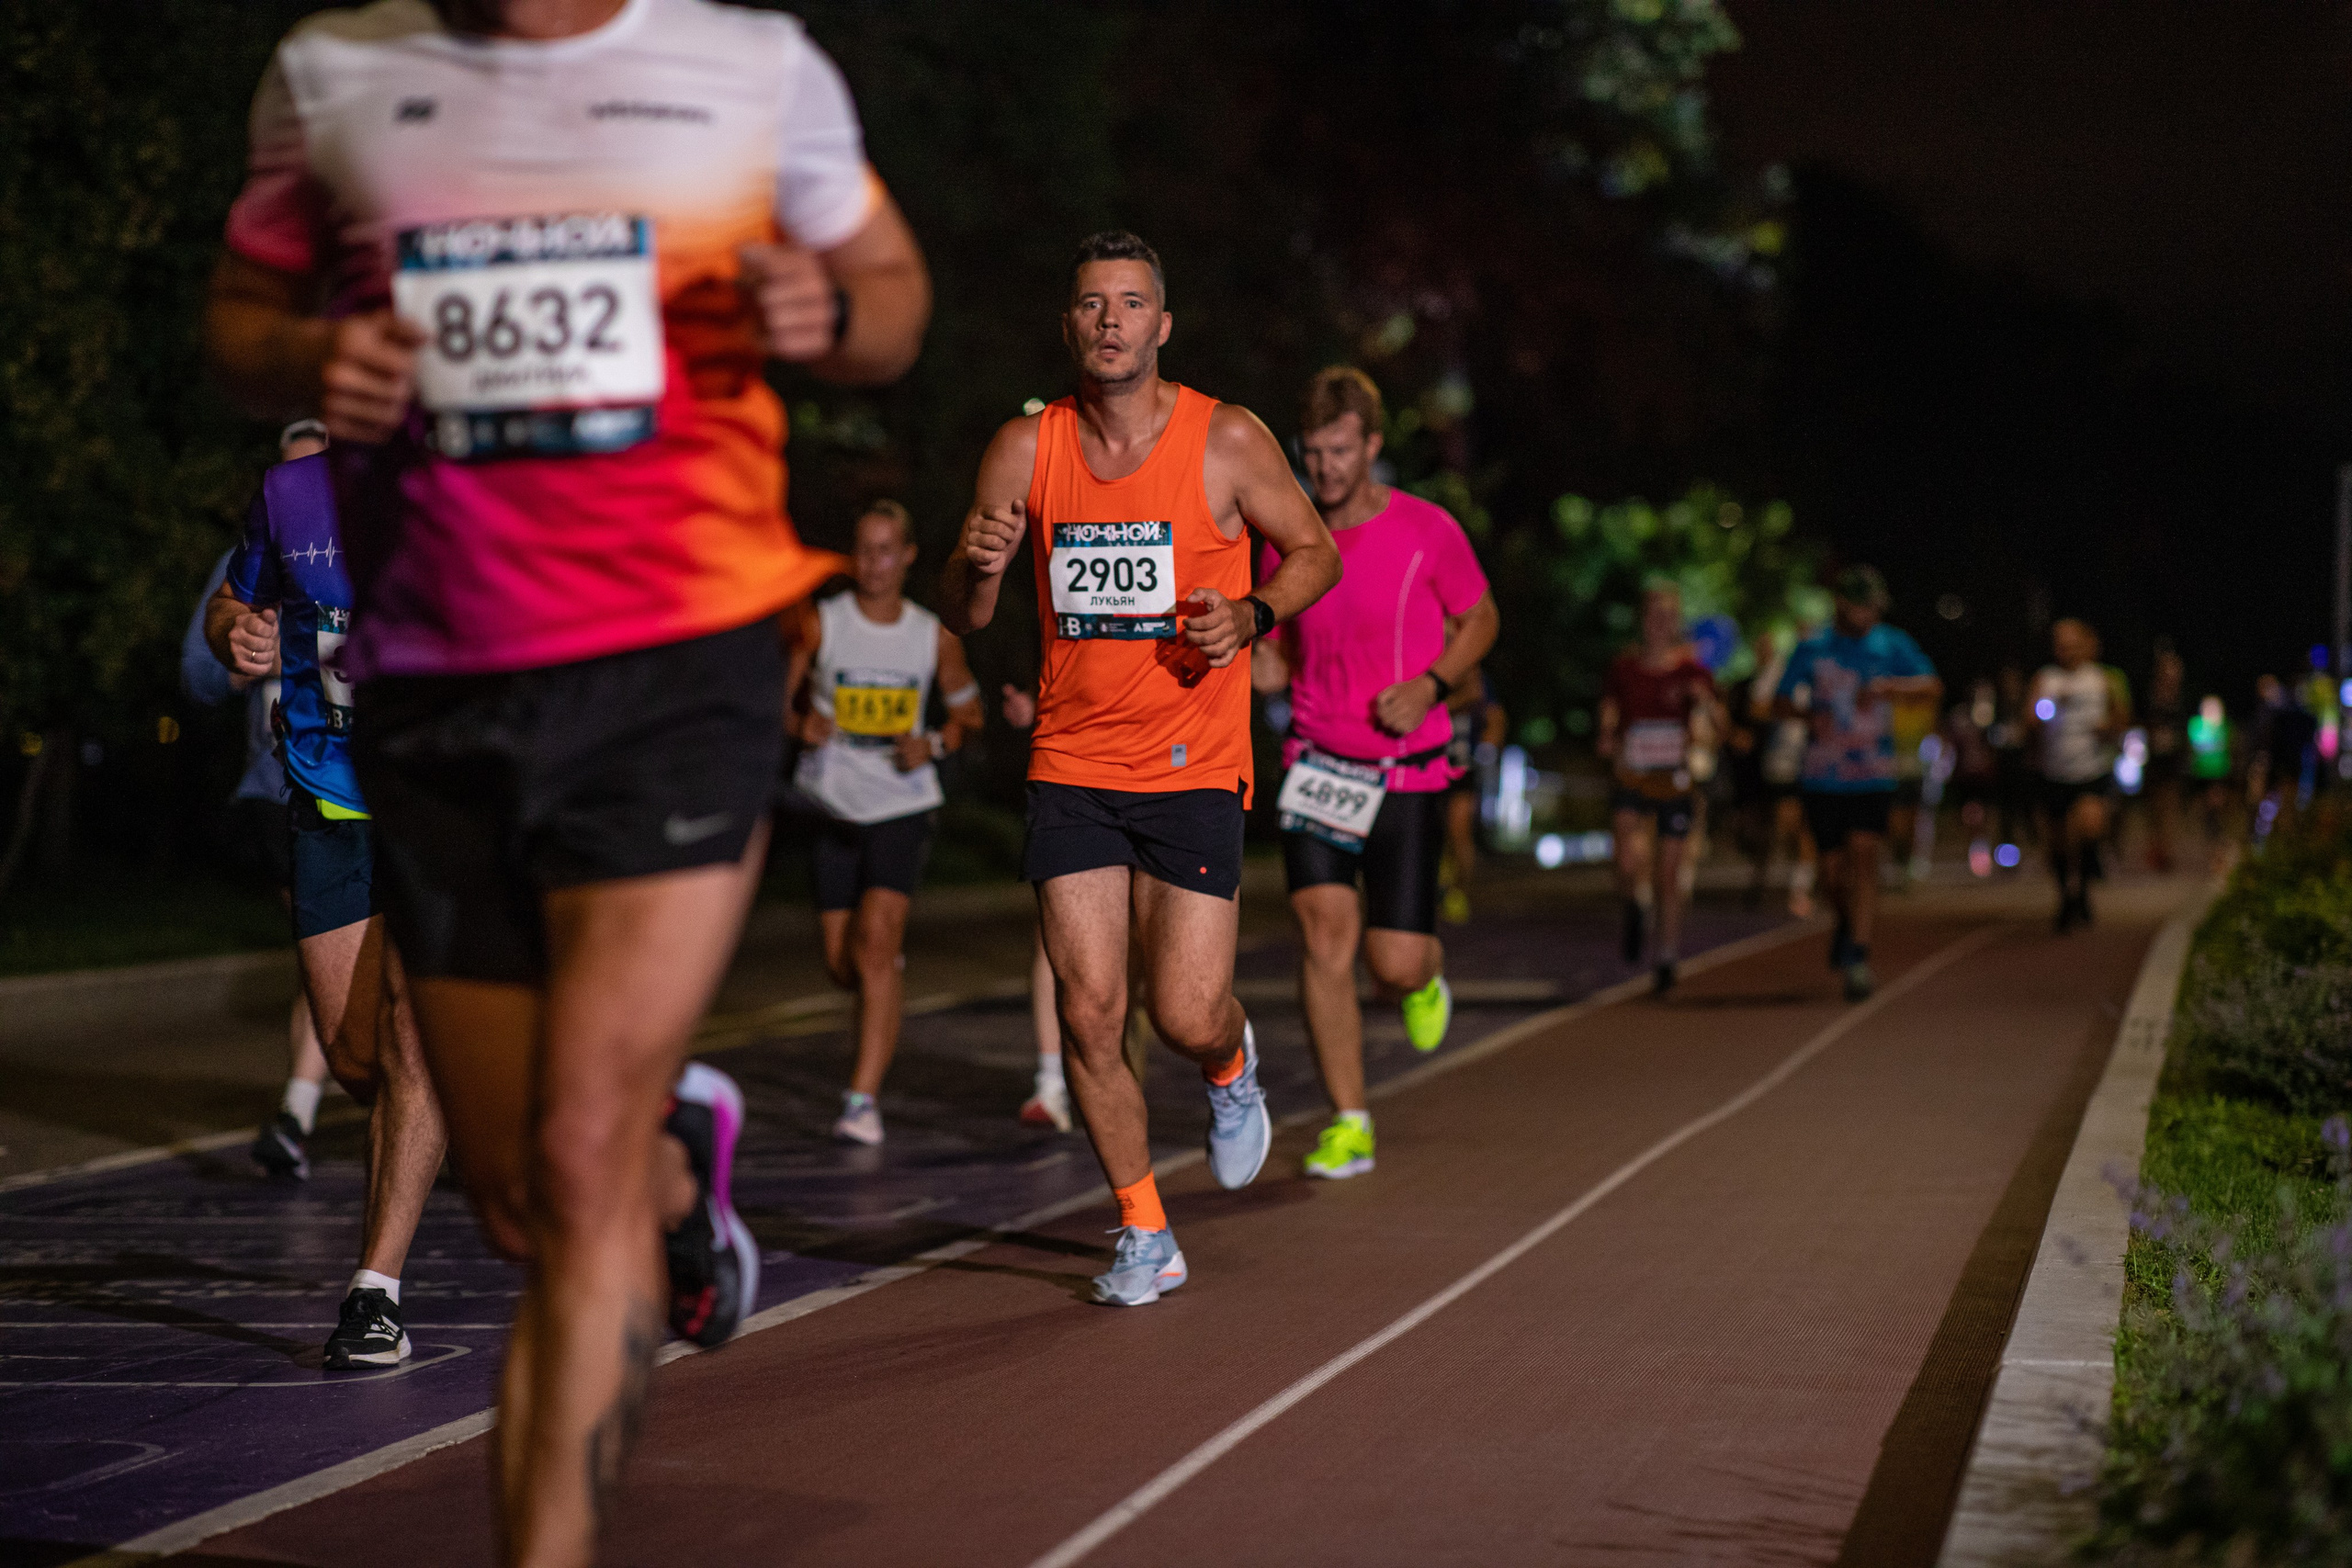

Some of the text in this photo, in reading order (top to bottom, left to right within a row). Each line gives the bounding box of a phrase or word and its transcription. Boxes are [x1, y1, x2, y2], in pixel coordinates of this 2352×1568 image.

[434, 284, 626, 364] 8632
[1066, 521, 1161, 542] НОЧНОЙ
[1067, 558, 1159, 592] 2903
[1091, 596, 1136, 606] ЛУКЬЯН
[1297, 778, 1369, 816] 4899
